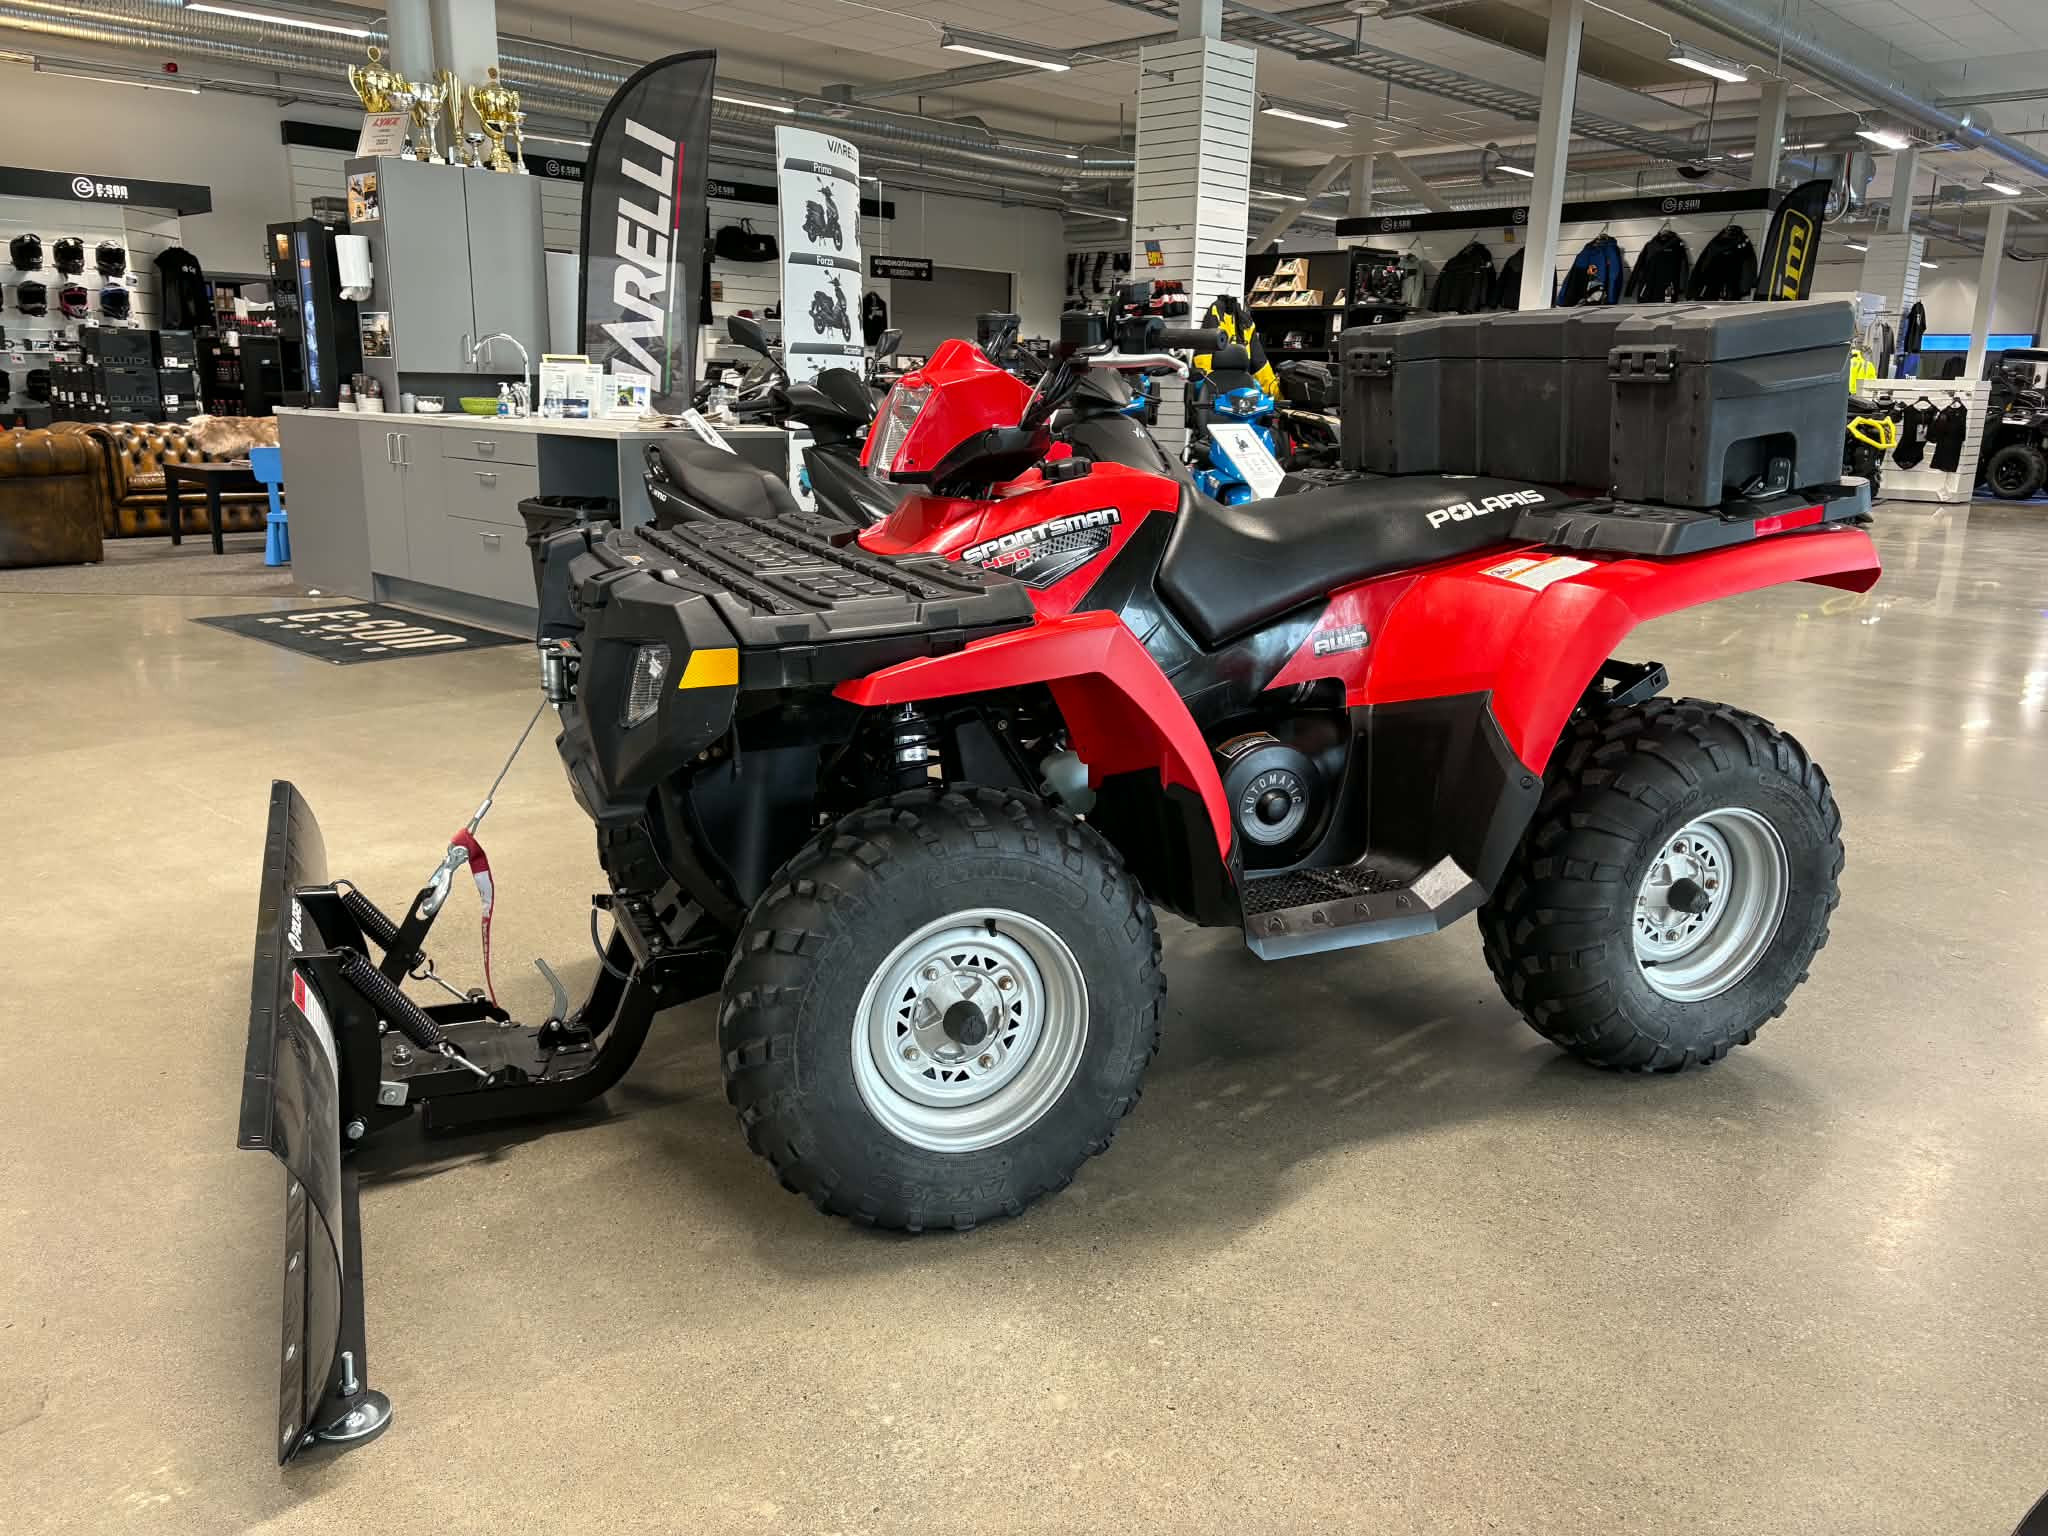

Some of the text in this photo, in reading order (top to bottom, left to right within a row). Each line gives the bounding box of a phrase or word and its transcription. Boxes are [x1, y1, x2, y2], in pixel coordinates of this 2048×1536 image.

[1425, 489, 1545, 529] POLARIS
[962, 508, 1120, 565] SPORTSMAN
[981, 547, 1031, 570] 450
[1244, 773, 1302, 815] AUTOMATIC
